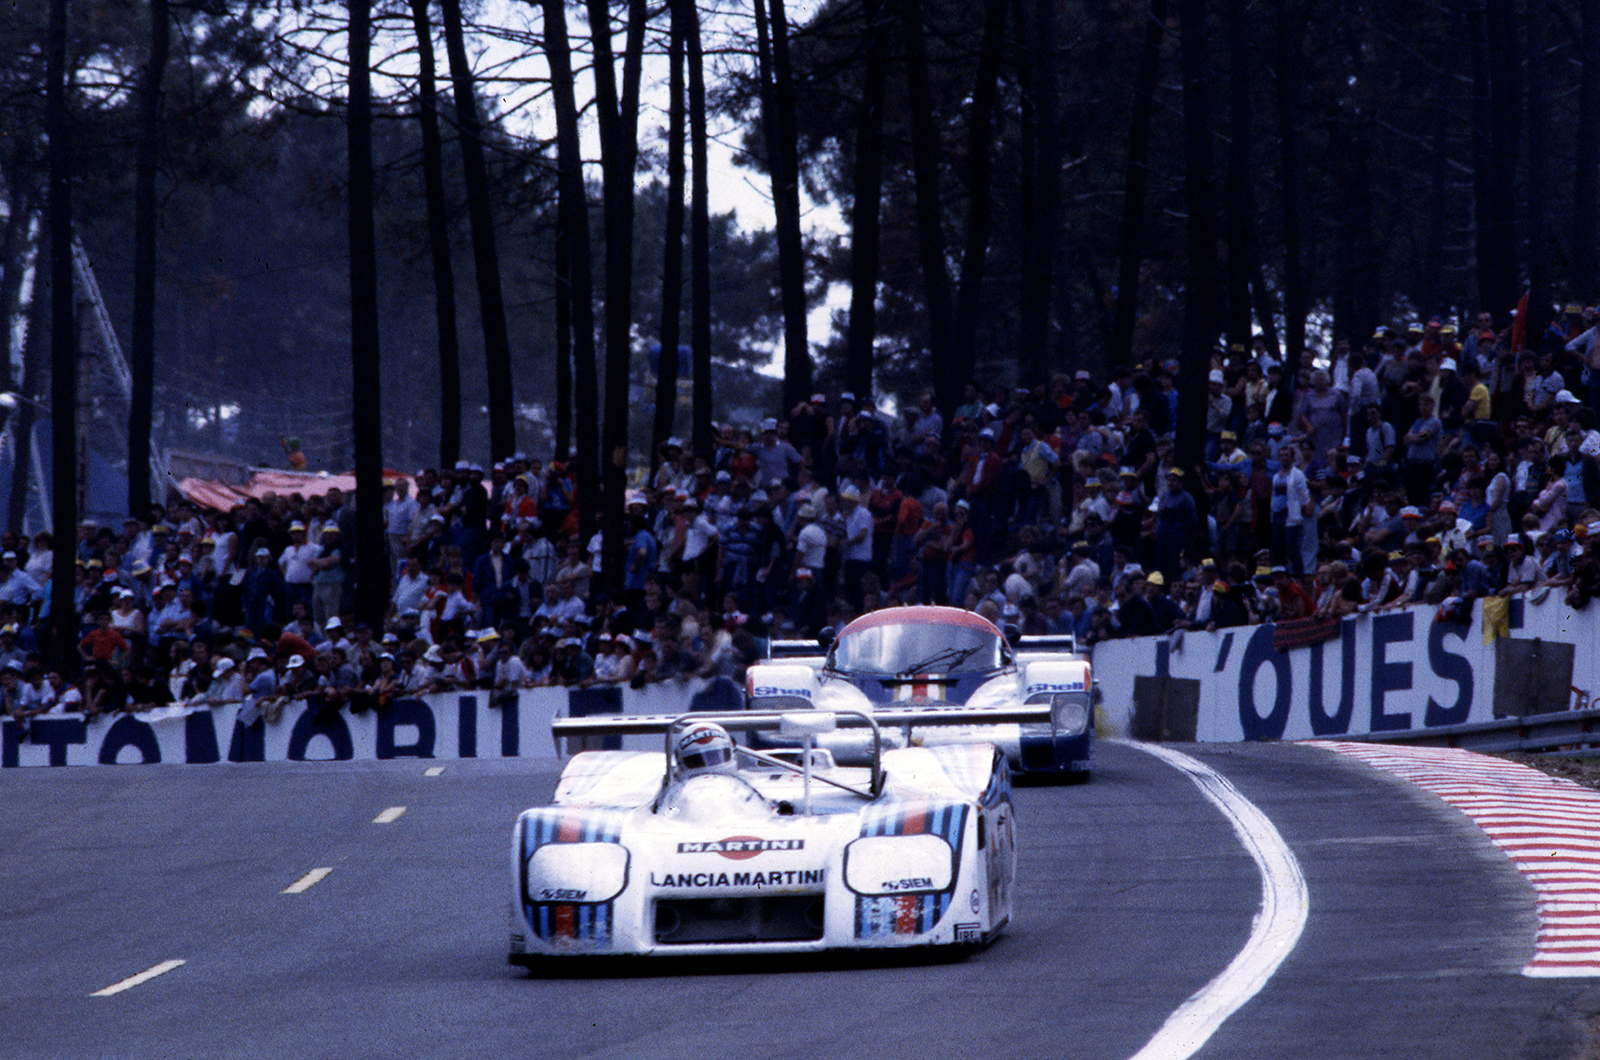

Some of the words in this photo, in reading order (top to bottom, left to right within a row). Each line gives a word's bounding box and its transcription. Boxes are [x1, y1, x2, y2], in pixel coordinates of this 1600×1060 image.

[681, 840, 800, 852] MARTINI
[650, 871, 730, 887] LANCIA
[733, 869, 825, 886] MARTINI
